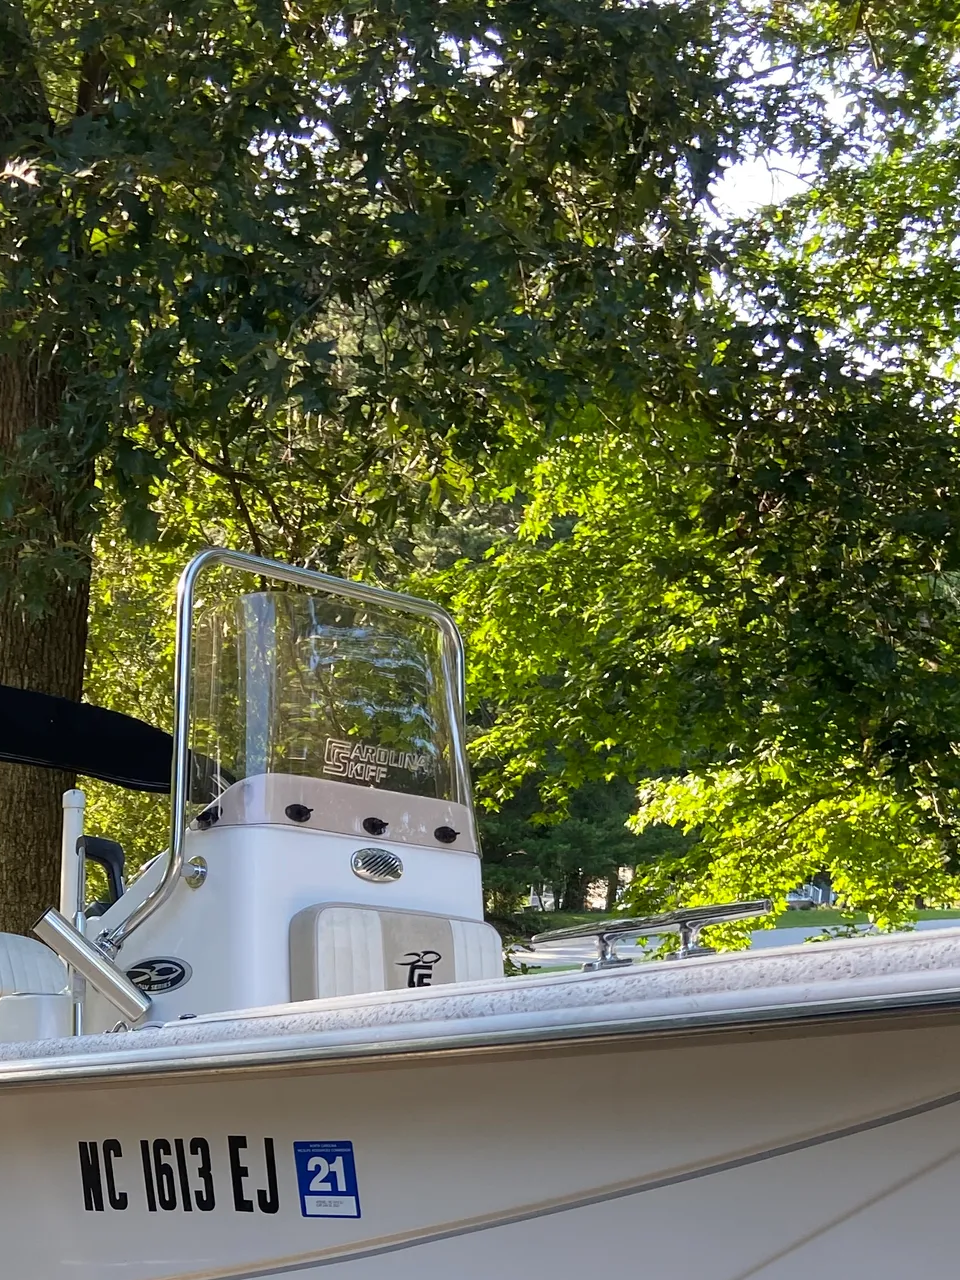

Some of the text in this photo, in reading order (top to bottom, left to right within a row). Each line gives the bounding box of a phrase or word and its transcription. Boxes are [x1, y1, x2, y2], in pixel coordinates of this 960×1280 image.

[323, 749, 387, 783] SKIFF
[324, 738, 429, 772] CAROLINA
[78, 1135, 280, 1214] NC 1613 EJ
[307, 1156, 347, 1191] 21
